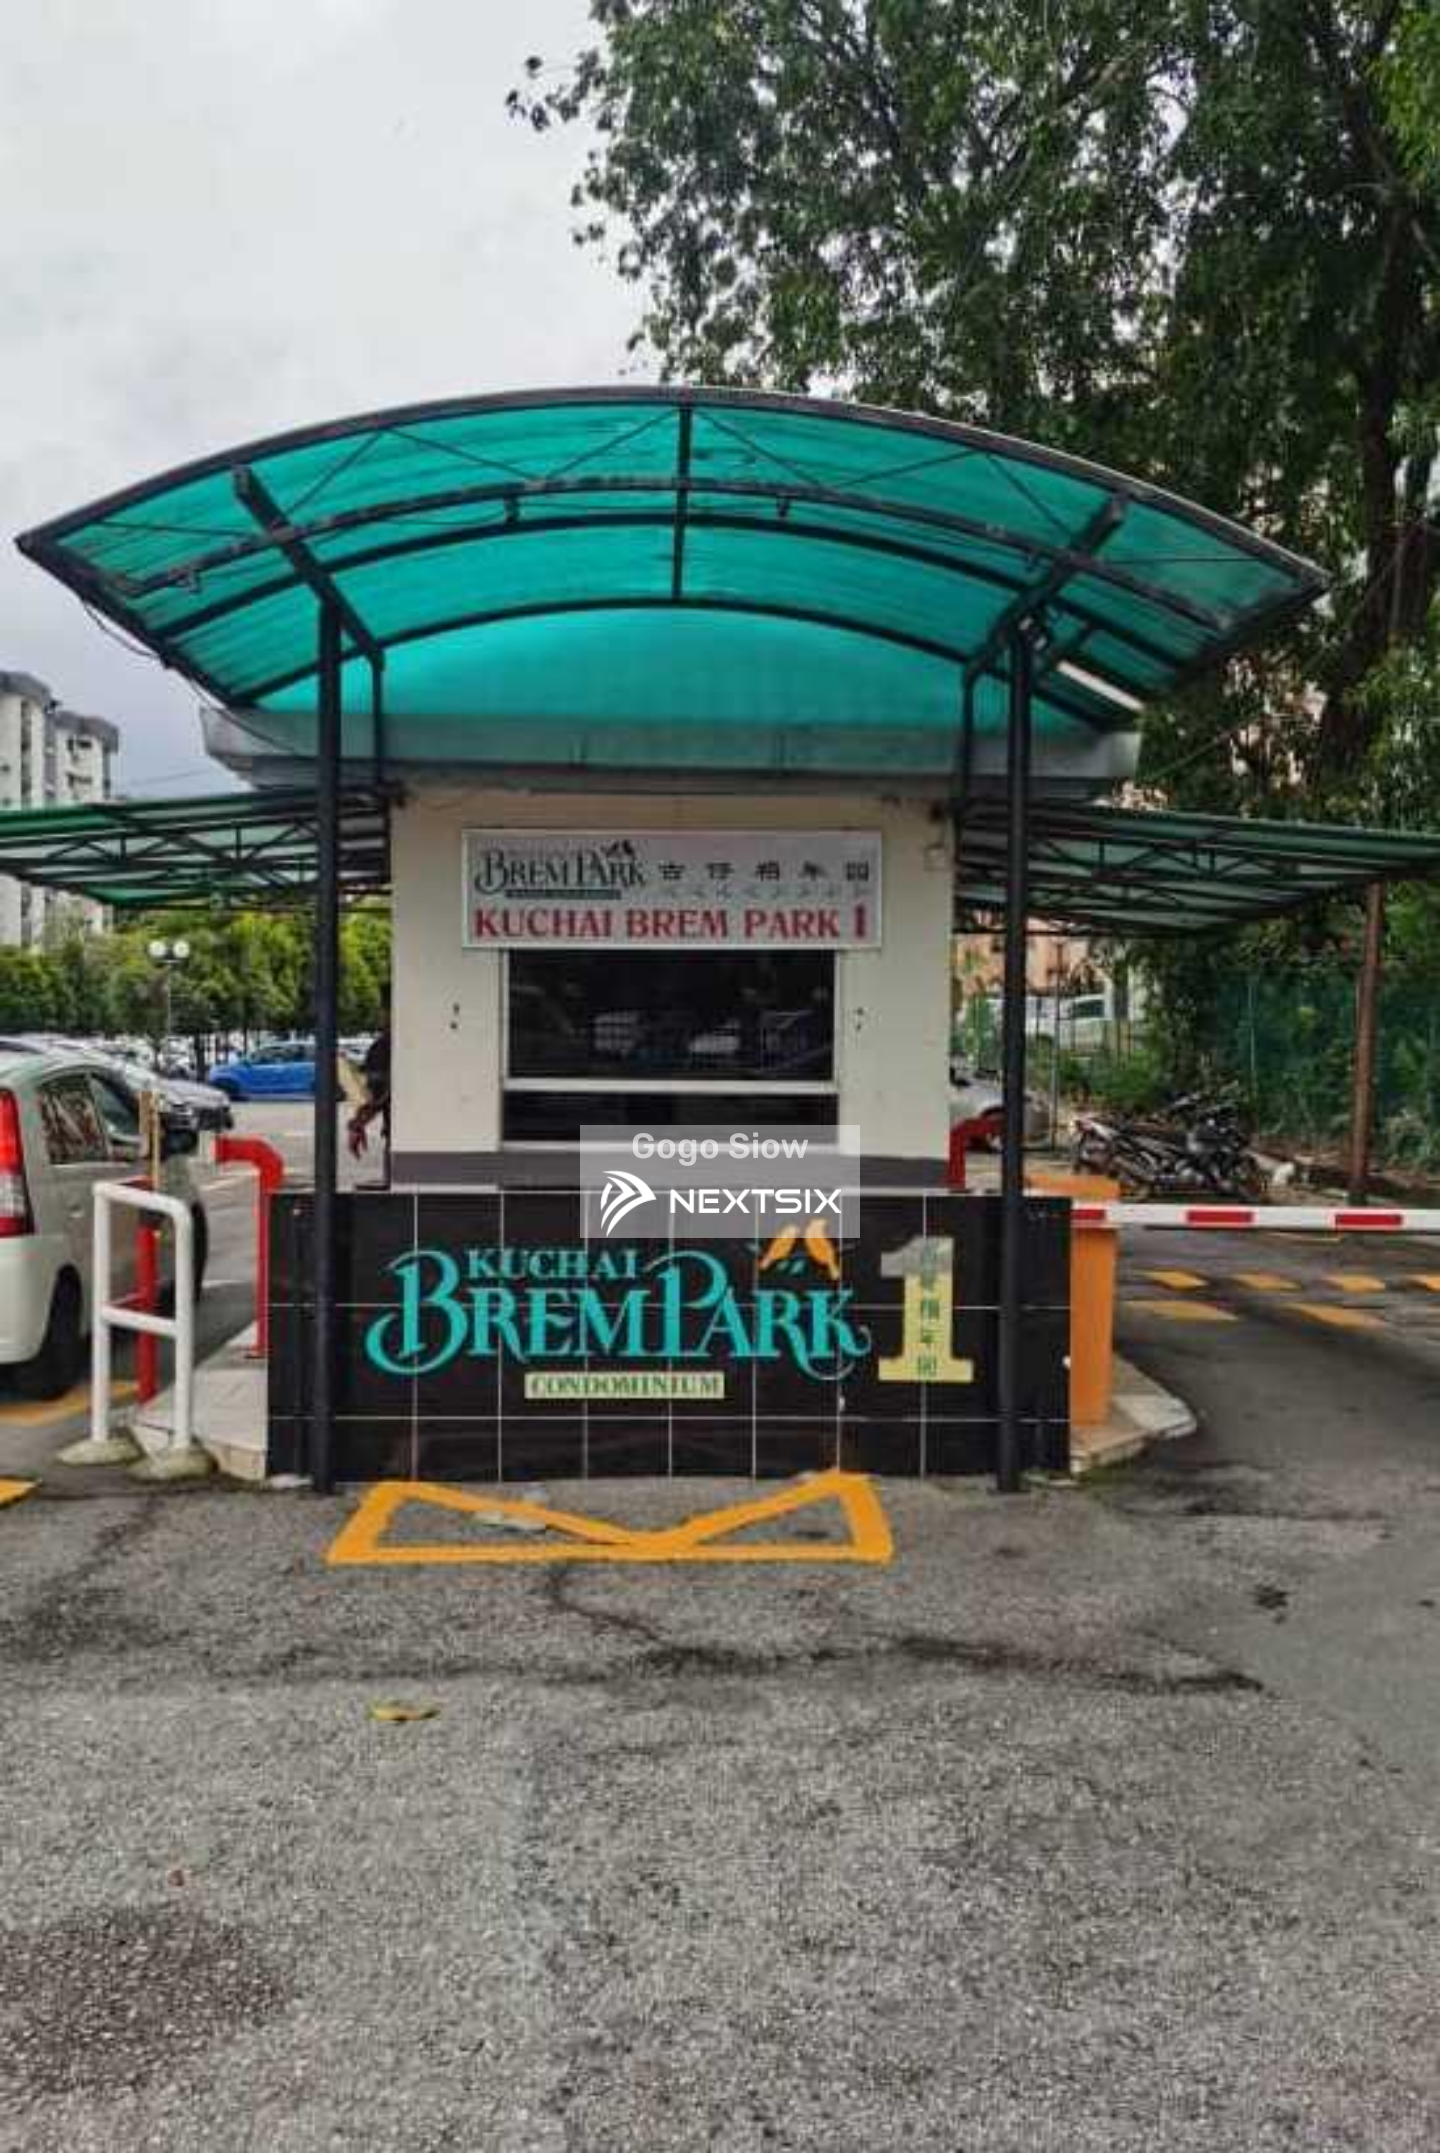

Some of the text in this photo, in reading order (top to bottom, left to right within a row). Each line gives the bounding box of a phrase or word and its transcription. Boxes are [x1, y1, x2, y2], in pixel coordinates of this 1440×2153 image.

[474, 909, 611, 938] KUCHAI
[627, 909, 728, 938] BREM
[743, 908, 839, 939] PARK
[468, 1248, 638, 1279] KUCHAI
[878, 1236, 974, 1382] 1
[530, 1376, 721, 1395] CONDOMINIUM
